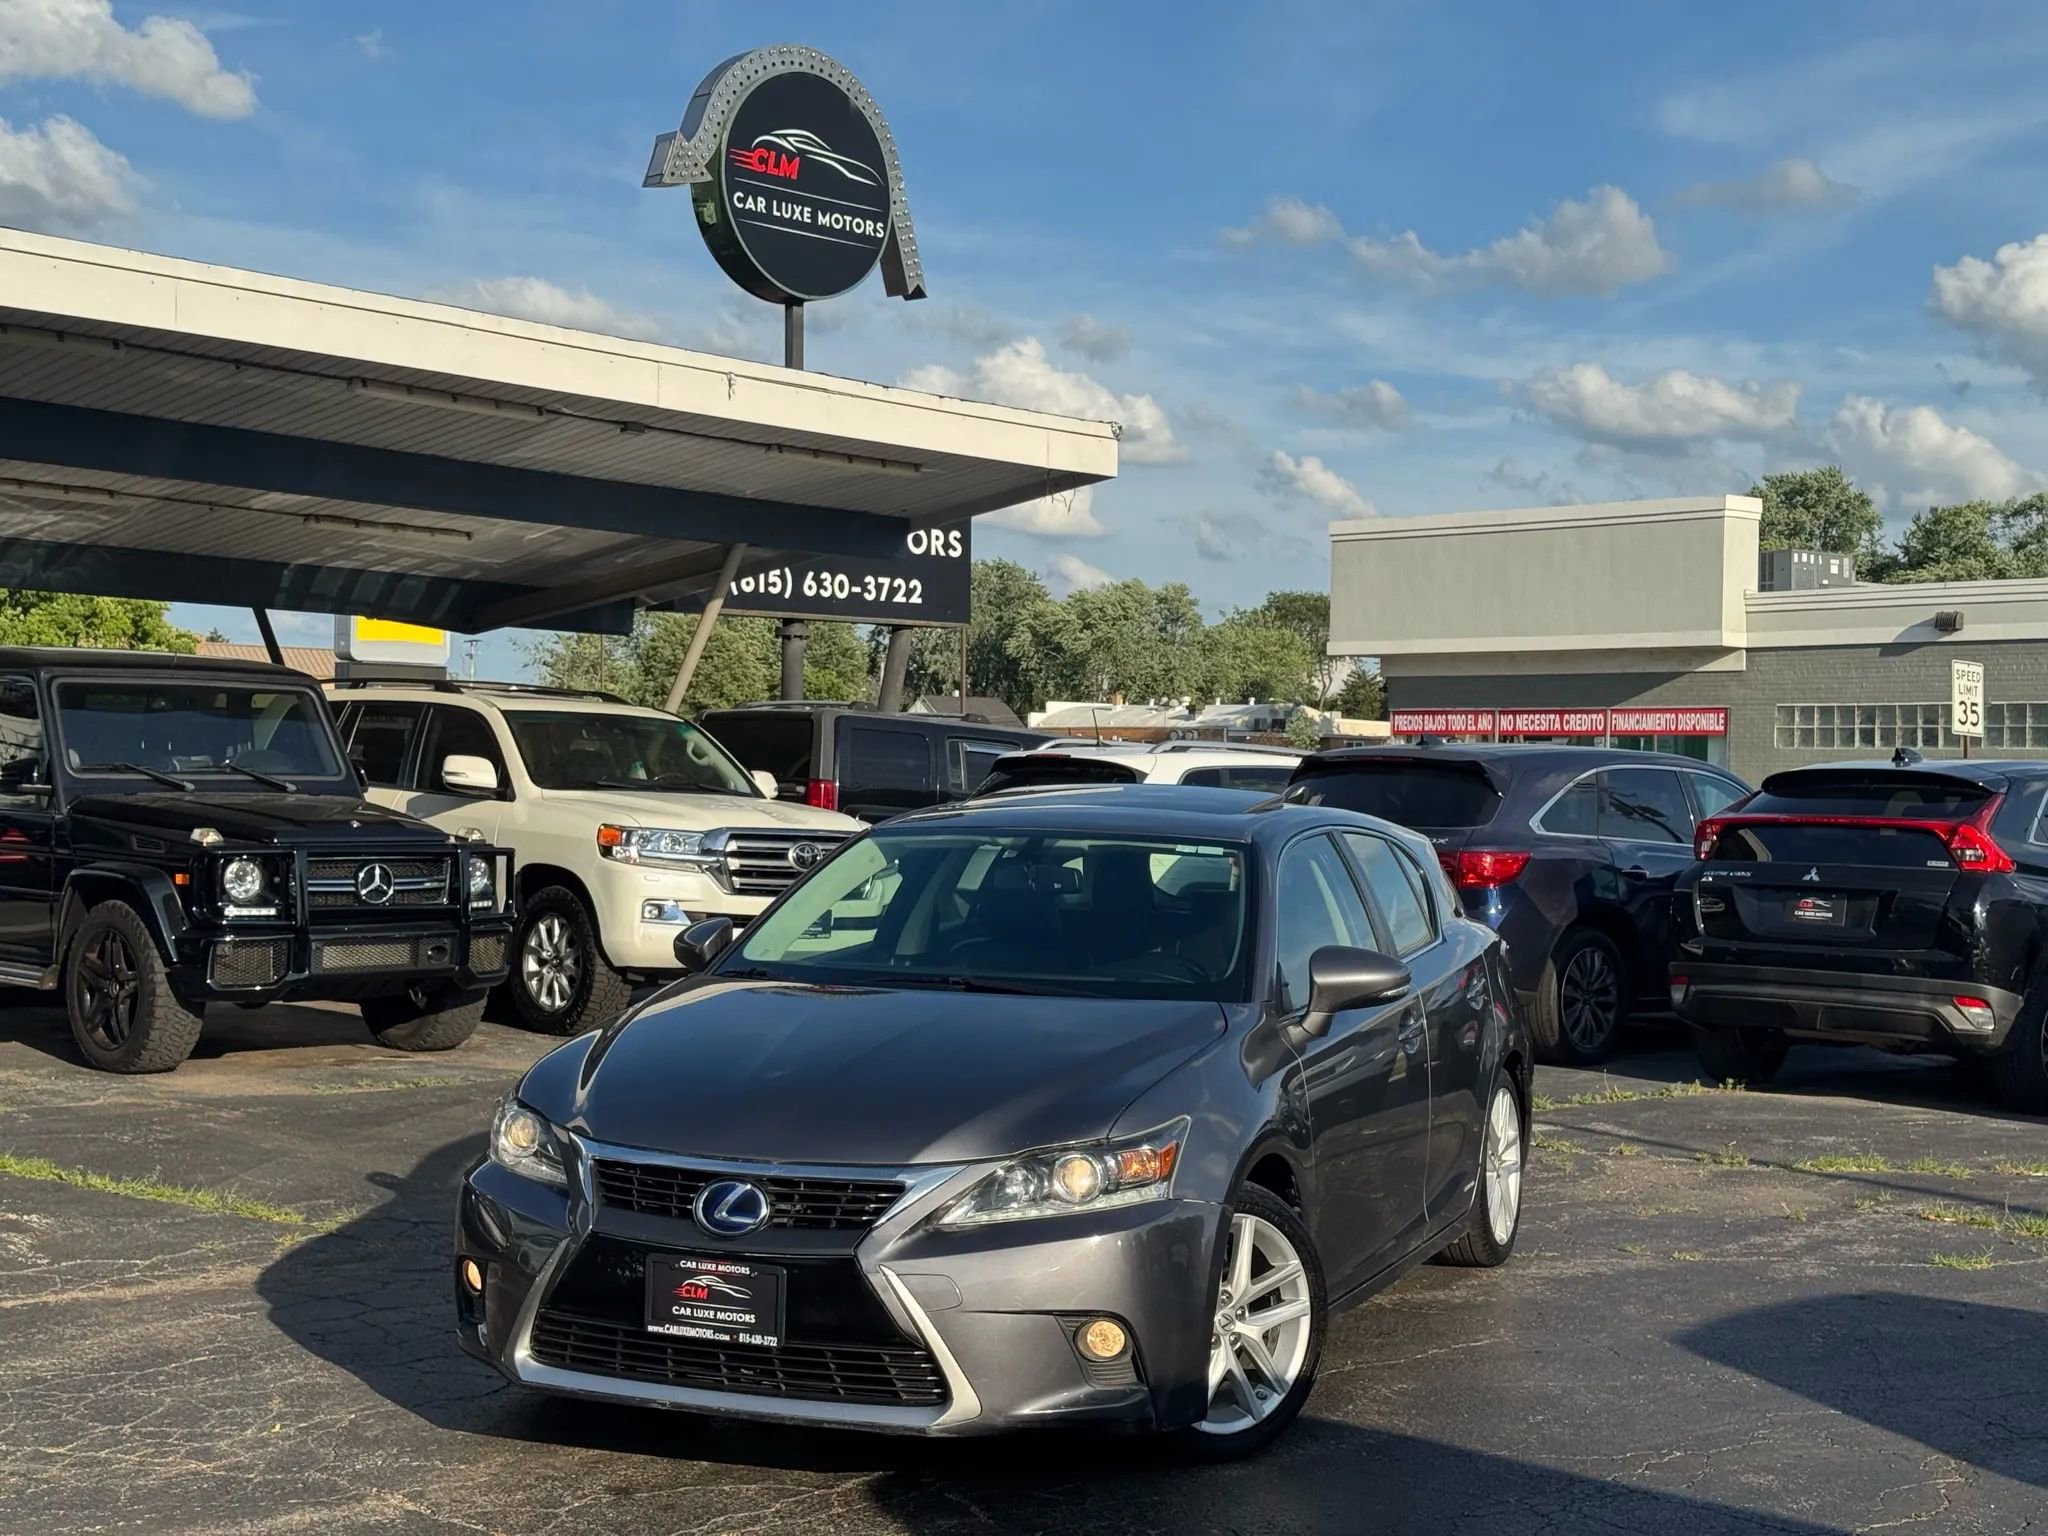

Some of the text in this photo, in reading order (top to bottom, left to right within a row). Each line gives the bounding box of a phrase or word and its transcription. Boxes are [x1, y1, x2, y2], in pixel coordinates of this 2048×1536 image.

[751, 148, 801, 180] CLM
[733, 190, 885, 239] CAR LUXE MOTORS
[906, 528, 963, 558] ORS
[803, 571, 923, 604] 630-3722
[1955, 668, 1981, 683] SPEED
[1958, 683, 1979, 697] LIMIT
[1394, 712, 1493, 731] PRECIOS BAJOS TODO EL AÑO
[1500, 712, 1605, 732] NO NECESITA CREDITO
[1611, 712, 1725, 731] FINANCIAMIENTO DISPONIBLE
[1958, 700, 1980, 727] 35
[679, 1260, 751, 1275] CAR LUXE MOTORS
[682, 1286, 709, 1300] CLM
[672, 1305, 756, 1324] CAR LUXE MOTORS
[738, 1332, 778, 1347] 815-630-3722
